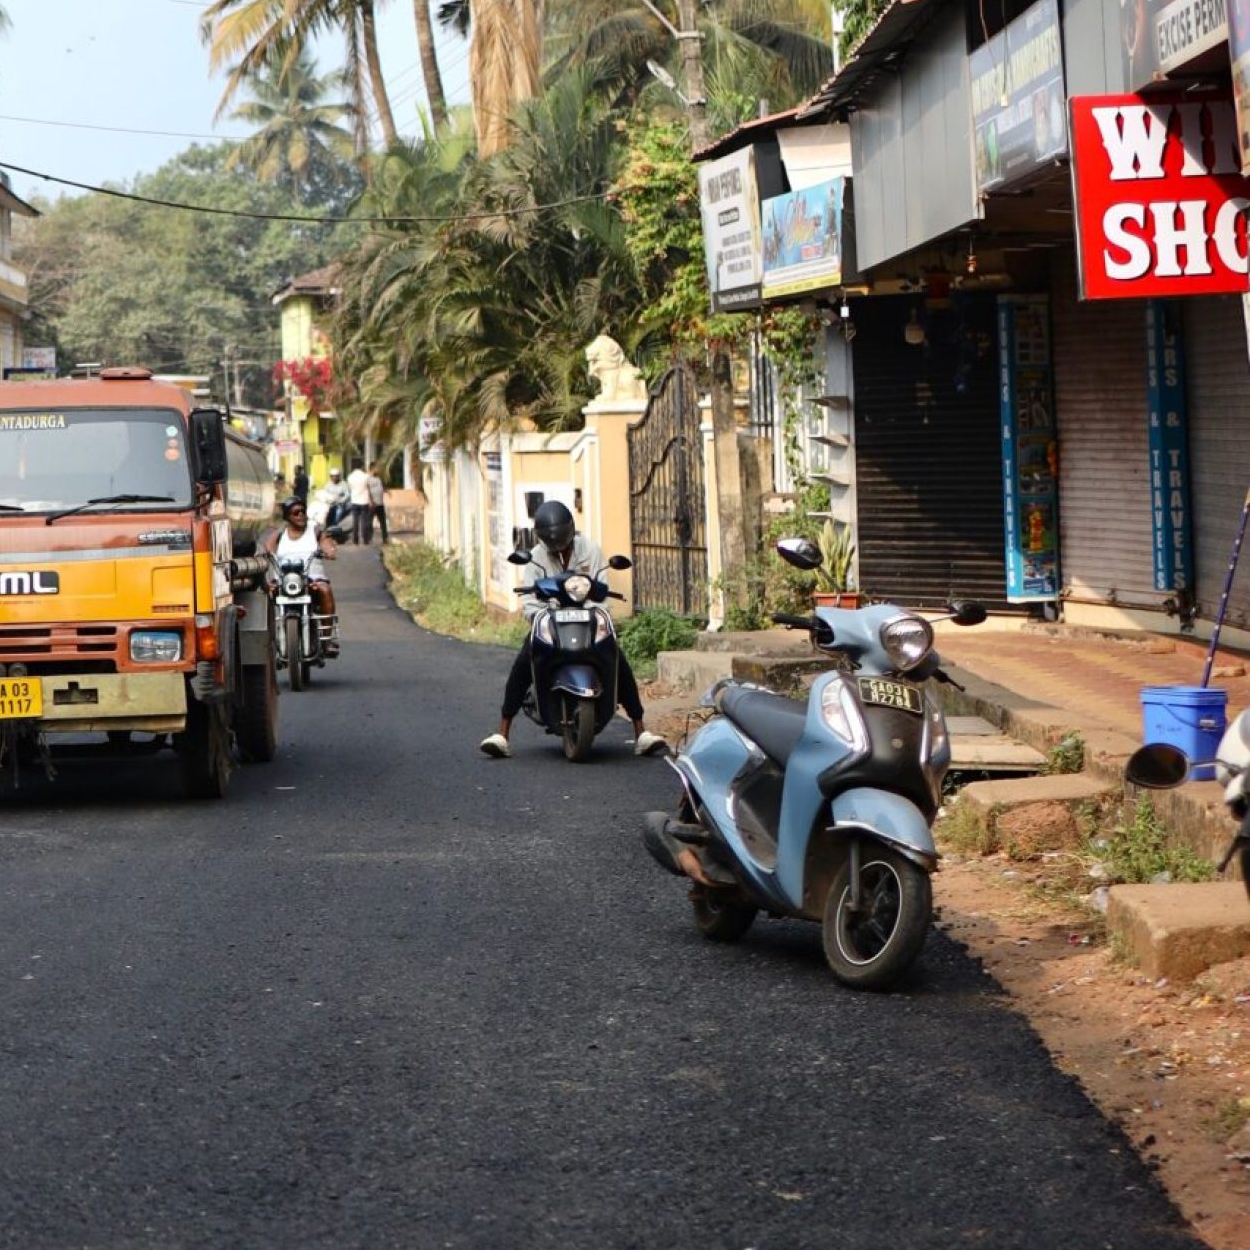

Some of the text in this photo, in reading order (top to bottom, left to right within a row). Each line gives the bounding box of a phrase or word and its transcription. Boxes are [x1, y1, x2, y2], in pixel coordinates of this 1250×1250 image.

[1158, 6, 1192, 61] EXCISE
[1166, 410, 1181, 428] &
[1152, 449, 1165, 589] TRAVELS
[1168, 449, 1185, 589] TRAVELS
[12, 682, 29, 697] 03
